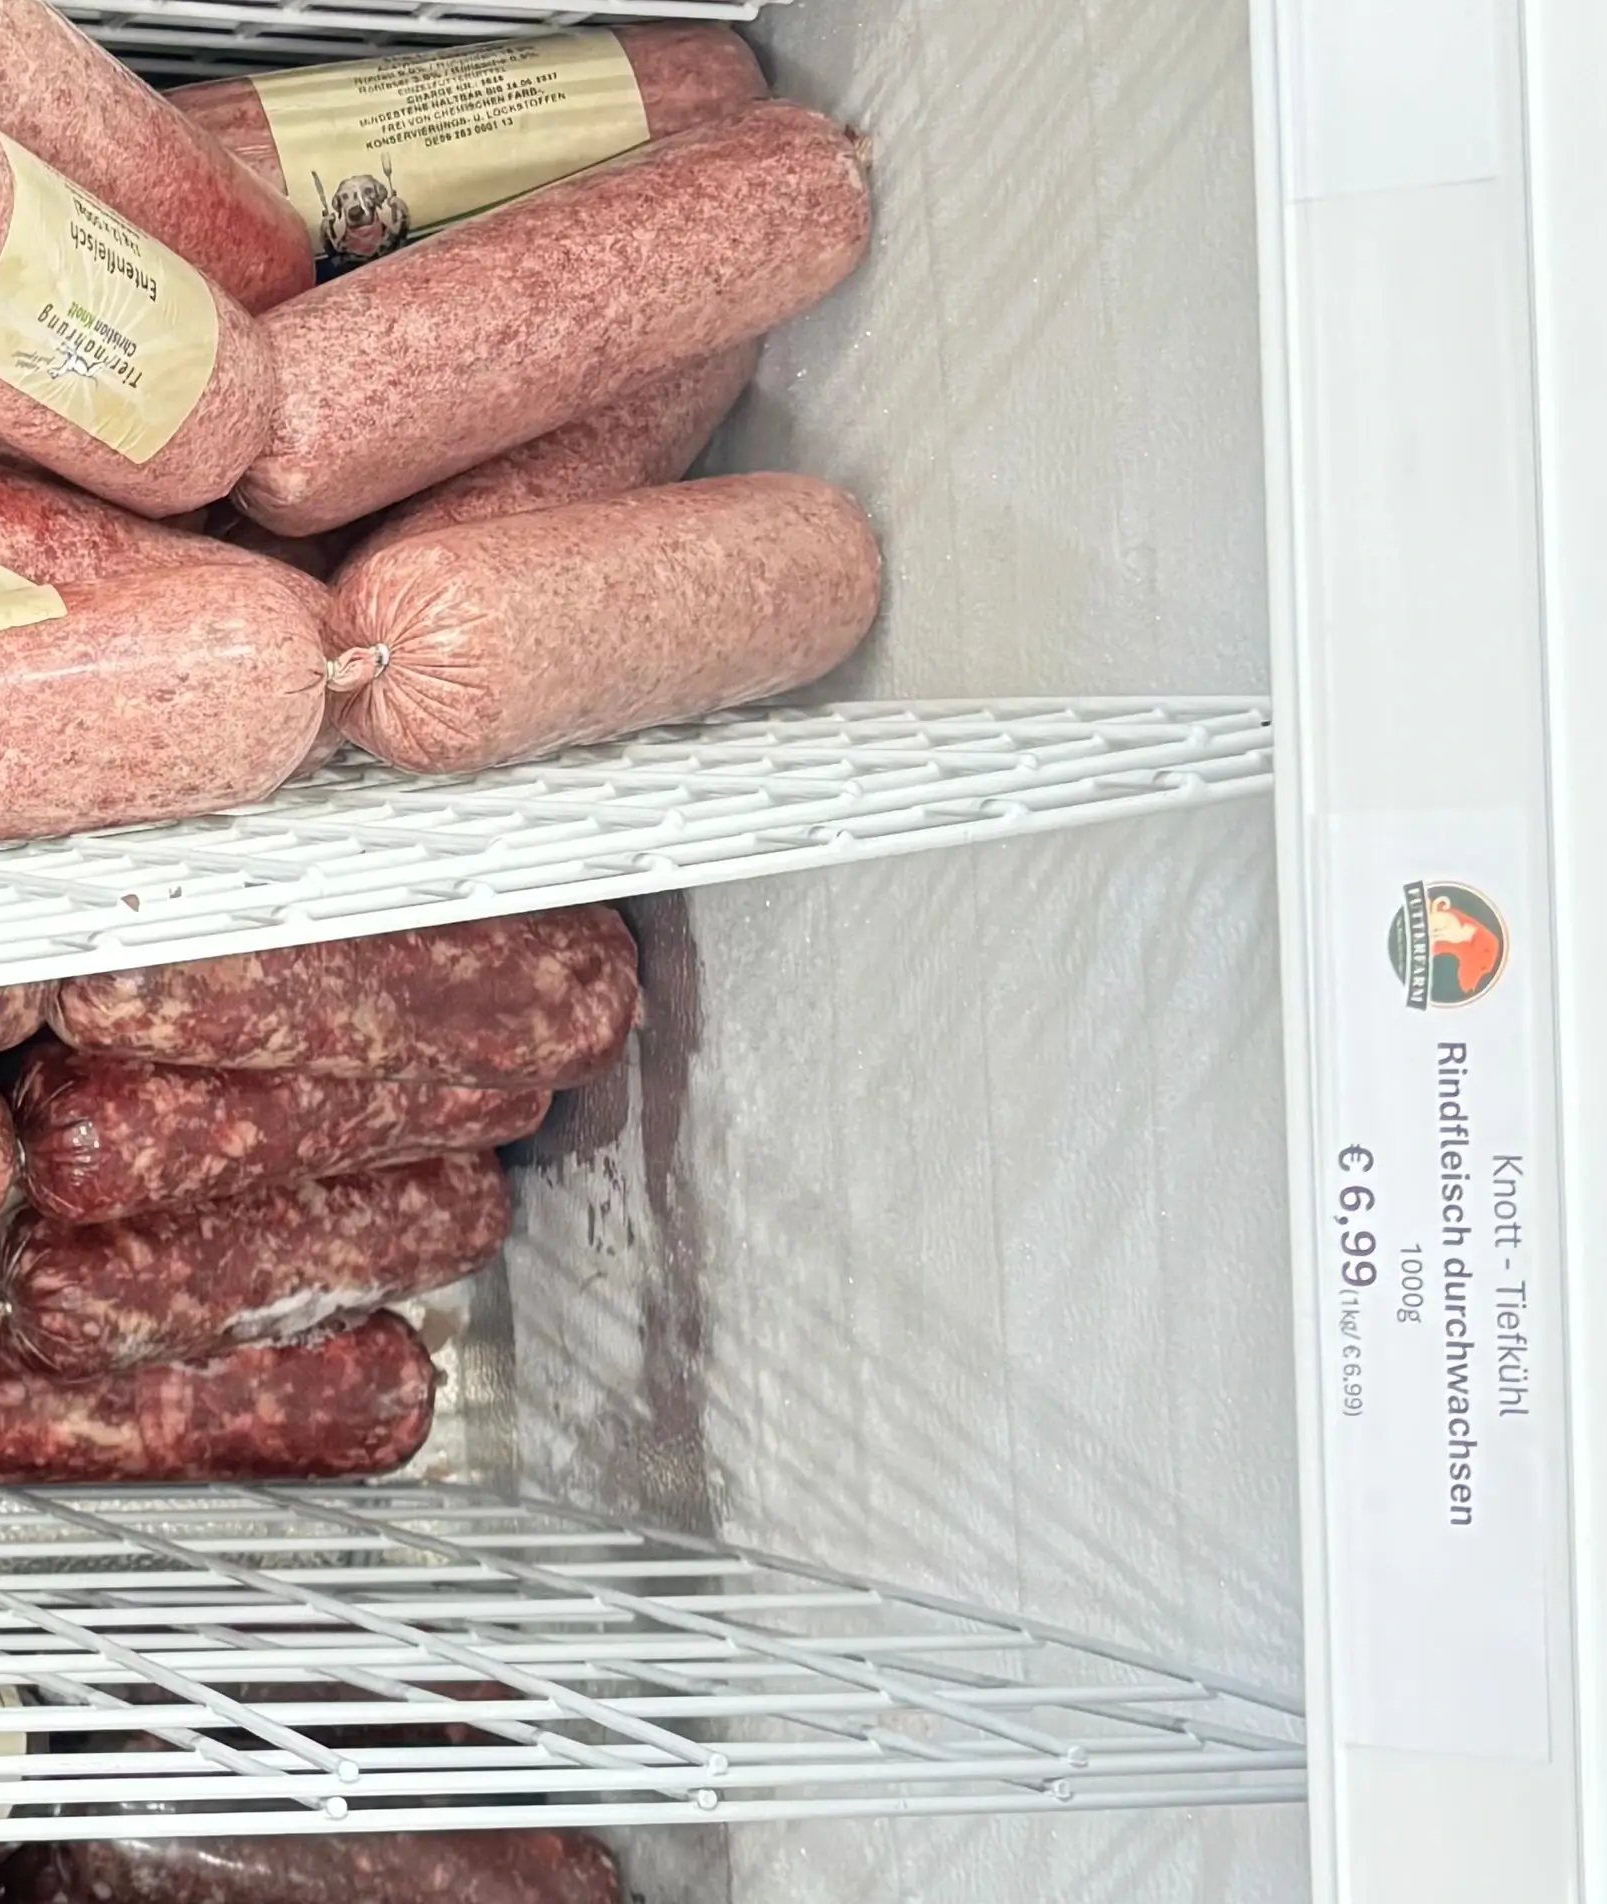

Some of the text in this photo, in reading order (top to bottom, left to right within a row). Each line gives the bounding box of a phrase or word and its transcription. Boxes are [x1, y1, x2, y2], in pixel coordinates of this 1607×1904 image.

[71, 222, 156, 302] Entenfleisch
[68, 302, 137, 357] Christian Knott
[1404, 886, 1428, 1003] FUTTERFARM
[1338, 1144, 1374, 1172] €
[1493, 1156, 1523, 1248] Knott
[1334, 1186, 1377, 1286] 6,99
[1397, 1244, 1424, 1323] 1000g
[1438, 1043, 1478, 1525] Rindfleisch durchwachsen
[1496, 1280, 1529, 1416] Tiefkühl
